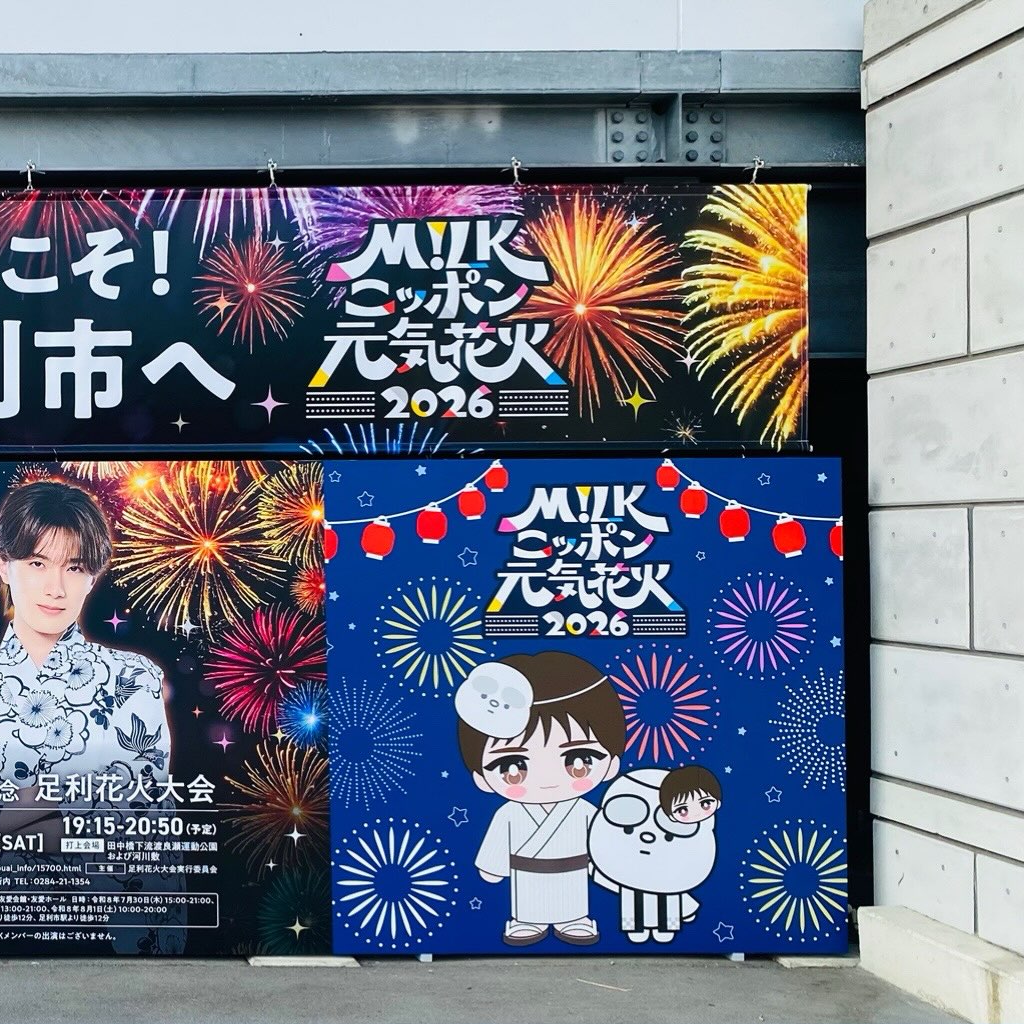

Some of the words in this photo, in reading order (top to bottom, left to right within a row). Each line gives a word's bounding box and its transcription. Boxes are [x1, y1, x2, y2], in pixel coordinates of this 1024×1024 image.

[345, 270, 529, 319] ニッポン
[307, 317, 567, 387] 元気花火
[380, 384, 494, 418] 2026
[513, 523, 654, 560] ニッポン
[486, 558, 684, 612] 元気花火
[542, 610, 629, 636] 2026
[35, 773, 216, 803] 足利花火大会
[62, 816, 183, 836] 19:15-20:50
[66, 840, 100, 850] 打上会場
[107, 841, 218, 851] 田中橋下流渡良瀬運動公園
[107, 851, 160, 861] および河川敷
[128, 865, 218, 874] 足利花火大会実行委員会
